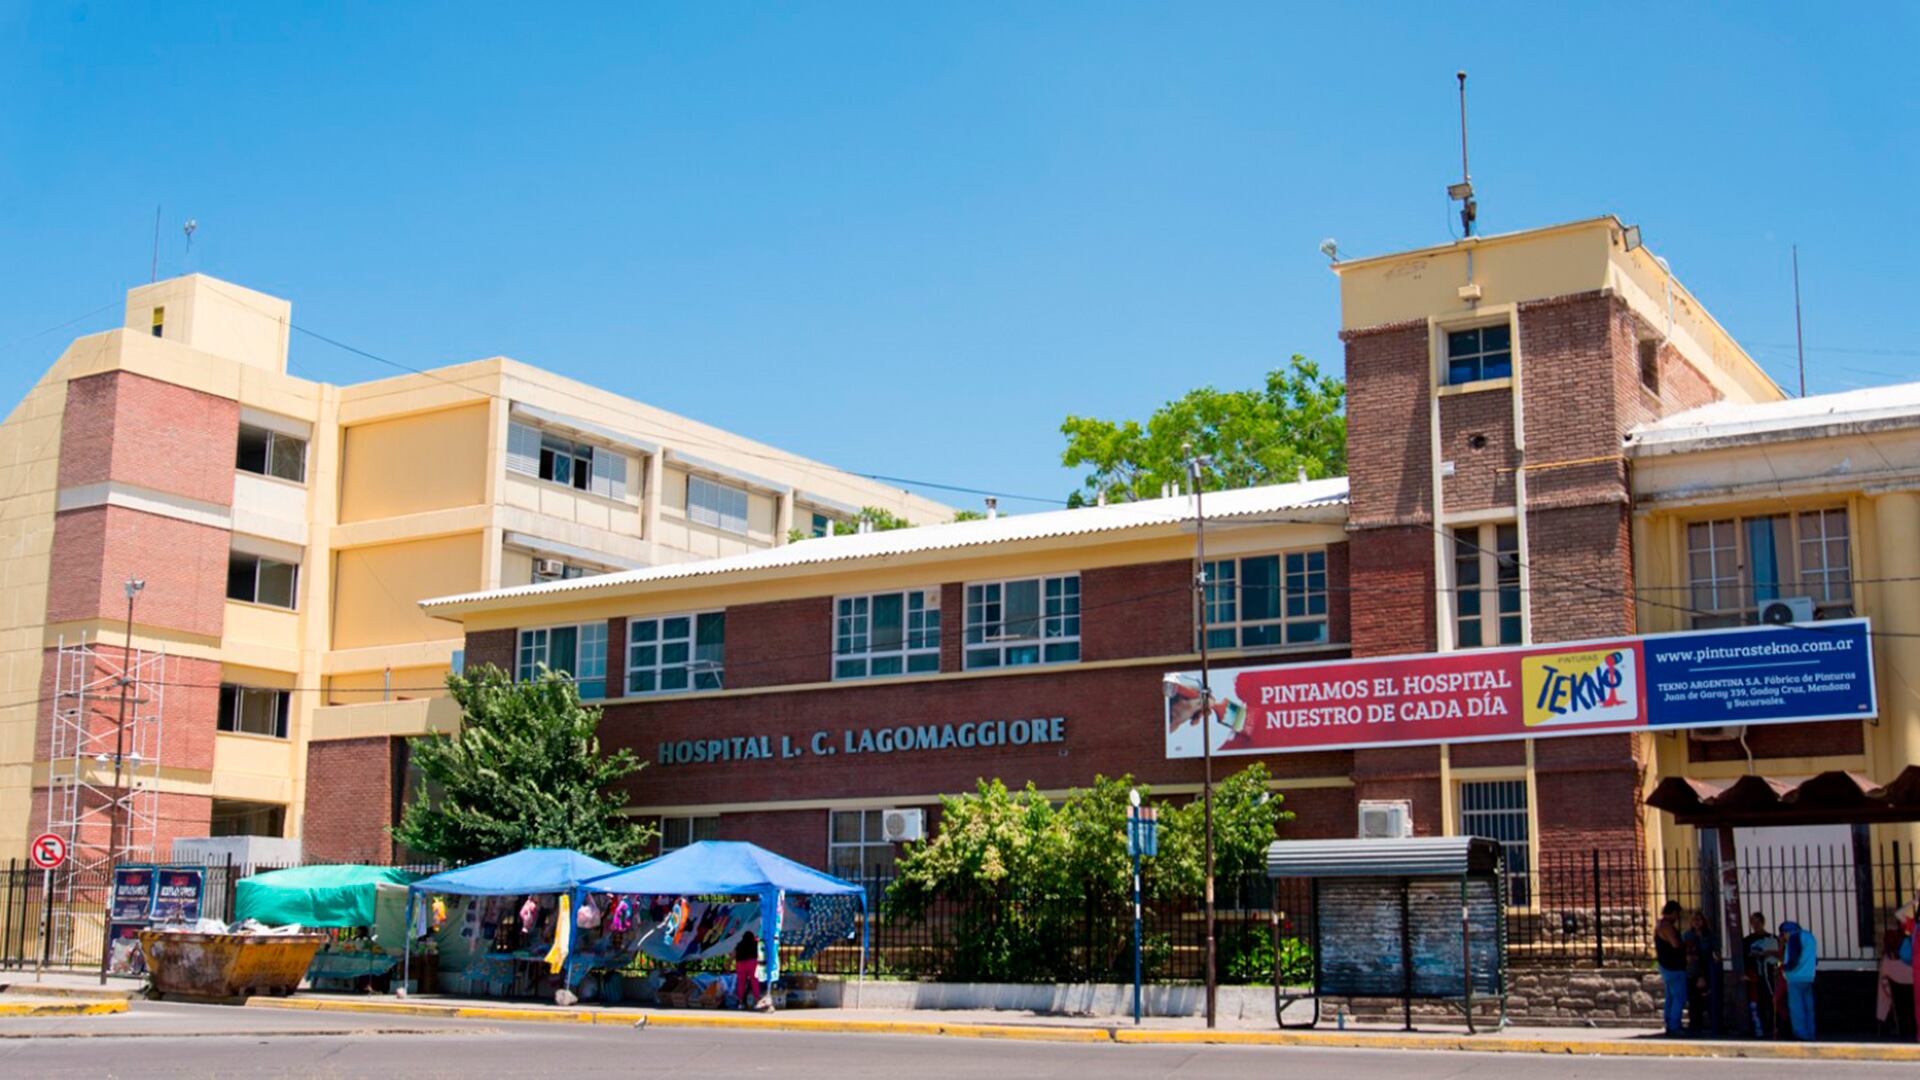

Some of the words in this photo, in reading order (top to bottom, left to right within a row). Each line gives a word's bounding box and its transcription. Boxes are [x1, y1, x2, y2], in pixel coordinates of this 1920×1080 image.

[1558, 654, 1599, 664] PINTURAS
[1655, 639, 1854, 663] www.pinturastekno.com.ar
[1261, 679, 1369, 705] PINTAMOS
[1373, 678, 1399, 697] EL
[1403, 669, 1512, 695] HOSPITAL
[1536, 665, 1623, 715] TEKNO
[1657, 681, 1689, 692] TEKNO
[1690, 678, 1744, 690] ARGENTINA
[1745, 677, 1763, 686] S.A.
[1764, 674, 1800, 685] Fábrica
[1802, 673, 1813, 682] de
[1815, 671, 1856, 682] Pinturas
[1664, 693, 1687, 702] Juan
[1687, 691, 1699, 700] de
[1700, 690, 1729, 700] Garay
[1730, 688, 1749, 698] 339,
[1750, 686, 1780, 697] Godoy
[1780, 685, 1806, 695] Cruz,
[1807, 682, 1851, 693] Mendoza
[1266, 705, 1363, 729] NUESTRO
[1367, 703, 1396, 723] DE
[1400, 699, 1463, 721] CADA
[1466, 691, 1508, 717] DÍA
[1734, 697, 1786, 708] Sucursales.
[657, 735, 773, 764] HOSPITAL
[781, 735, 802, 758] L.
[811, 731, 836, 756] C.
[845, 717, 1065, 753] LAGOMAGGIORE
